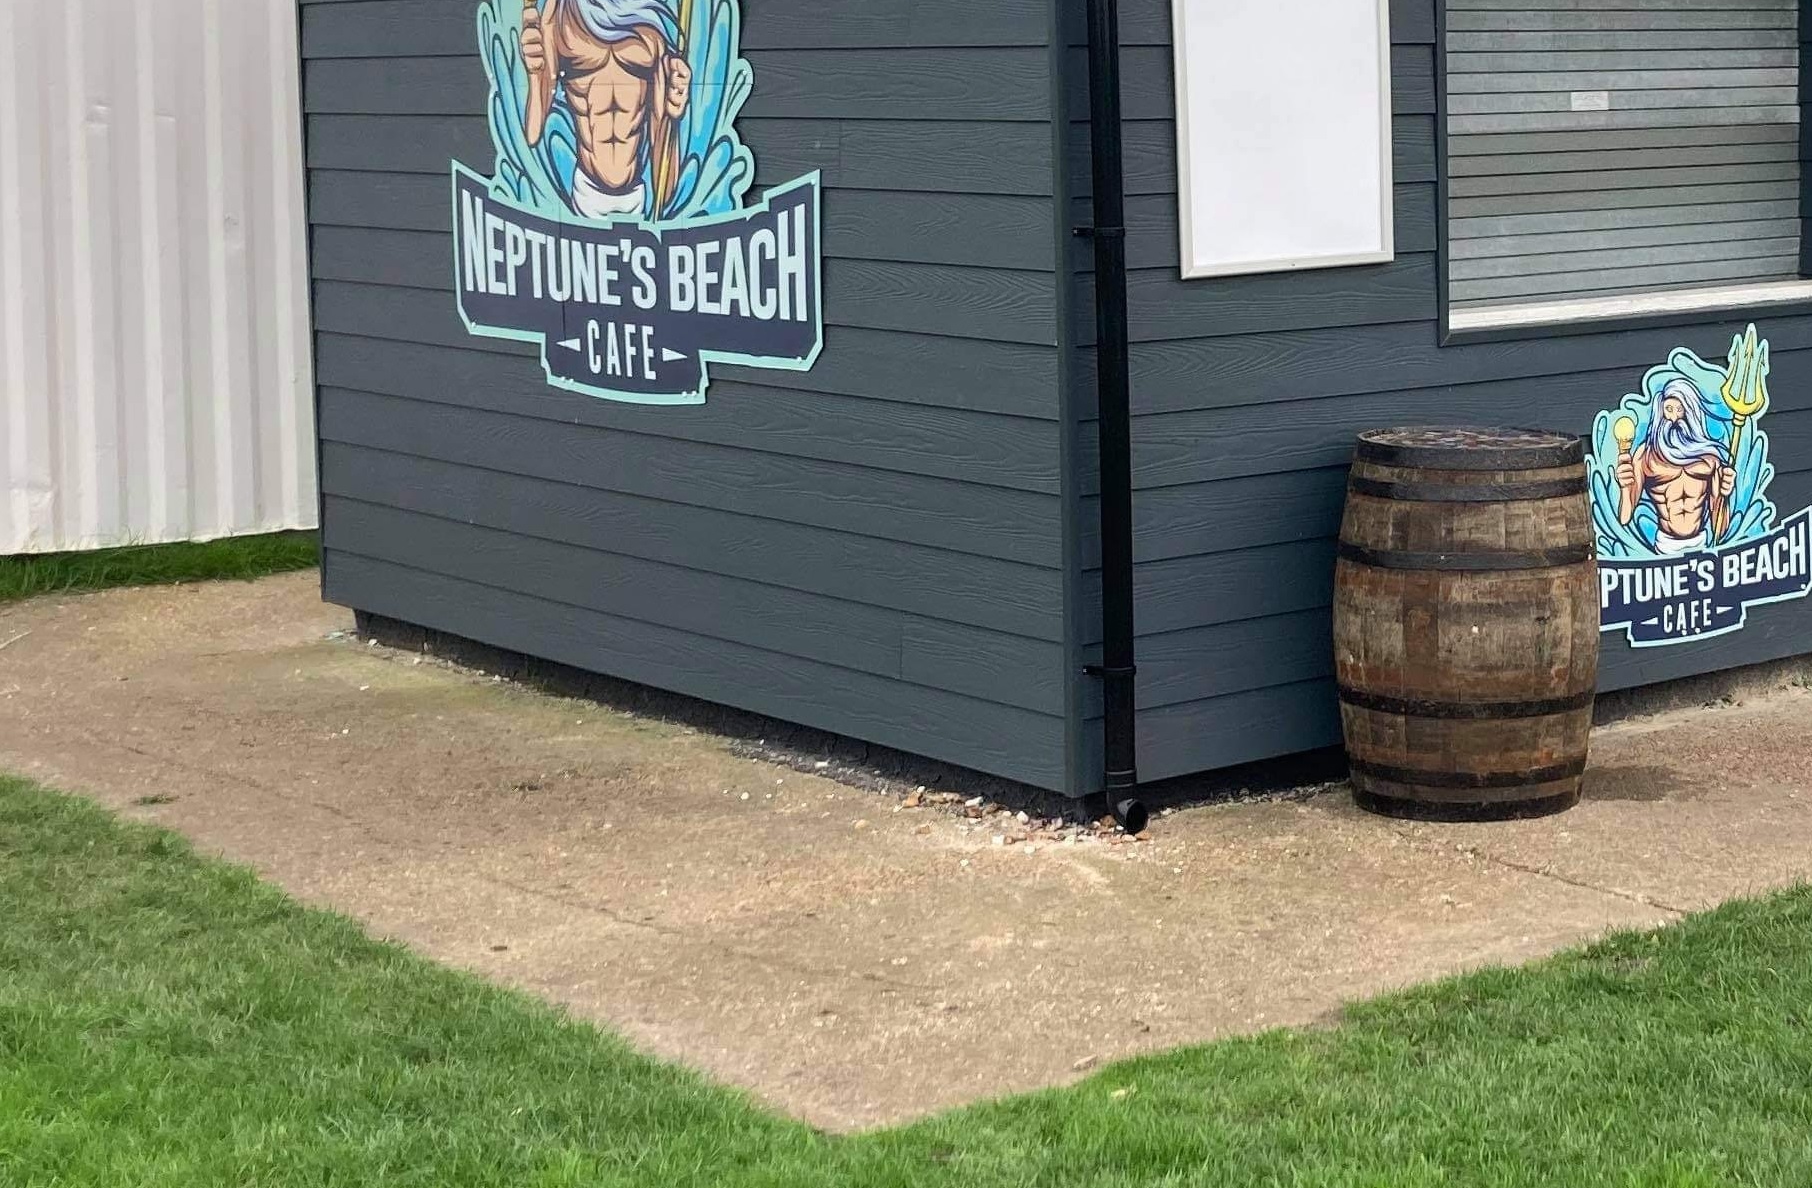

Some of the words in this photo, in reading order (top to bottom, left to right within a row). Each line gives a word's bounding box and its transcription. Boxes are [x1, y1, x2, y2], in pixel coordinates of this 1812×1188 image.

[462, 189, 656, 309] NEPTUNE'S
[668, 204, 807, 322] BEACH
[587, 319, 657, 380] CAFE
[1598, 559, 1715, 609] PTUNE'S
[1722, 522, 1806, 588] BEACH
[1663, 598, 1712, 633] CAFE
